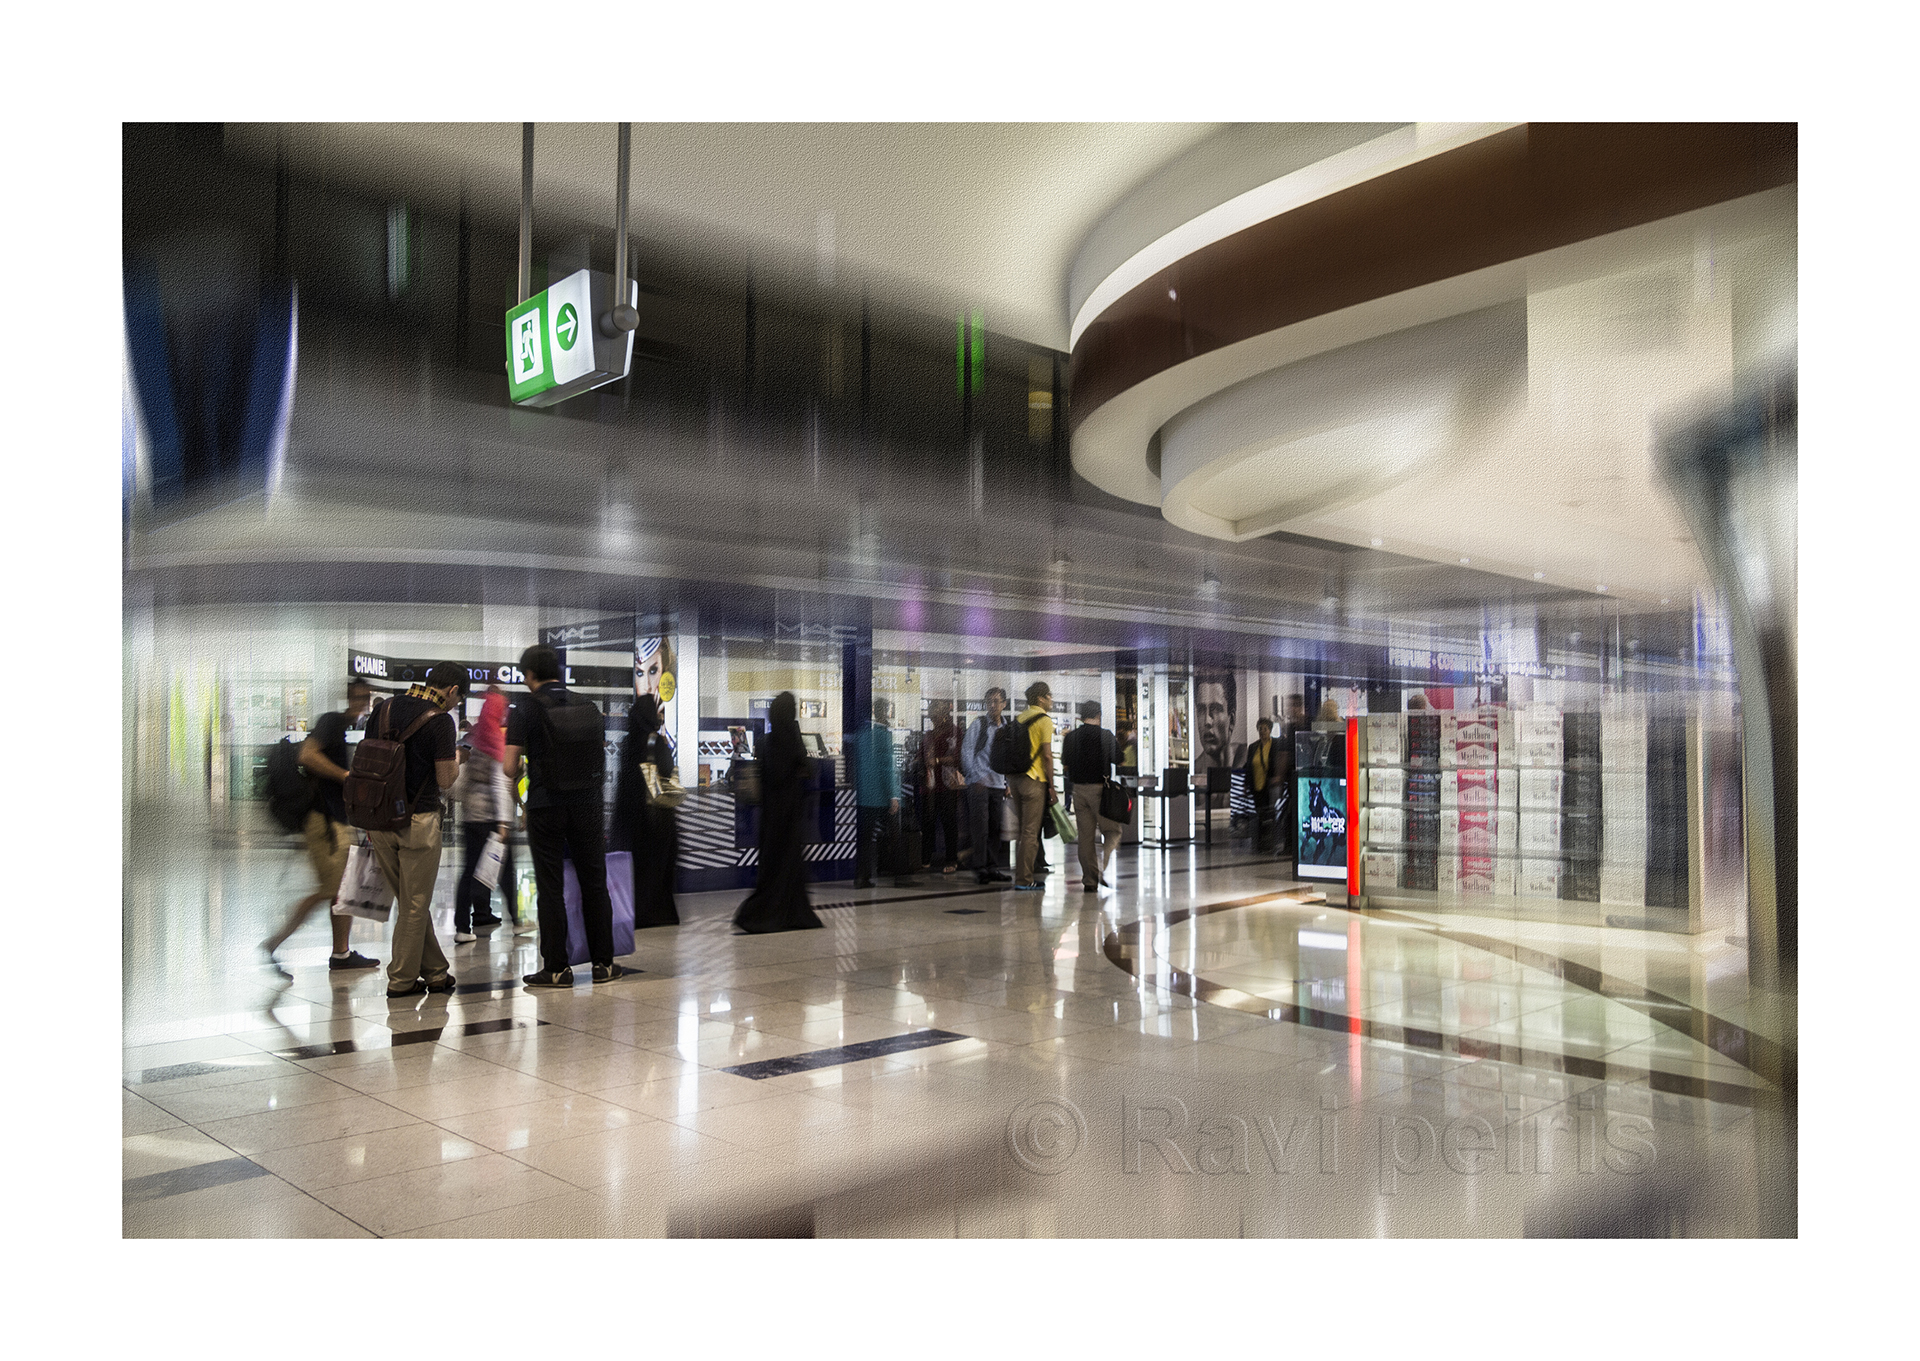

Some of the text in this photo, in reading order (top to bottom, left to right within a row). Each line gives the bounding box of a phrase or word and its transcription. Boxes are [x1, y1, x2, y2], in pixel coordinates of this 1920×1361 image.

[546, 624, 600, 643] MAC
[354, 655, 388, 677] CHANEL
[1462, 726, 1491, 740] Marlboro
